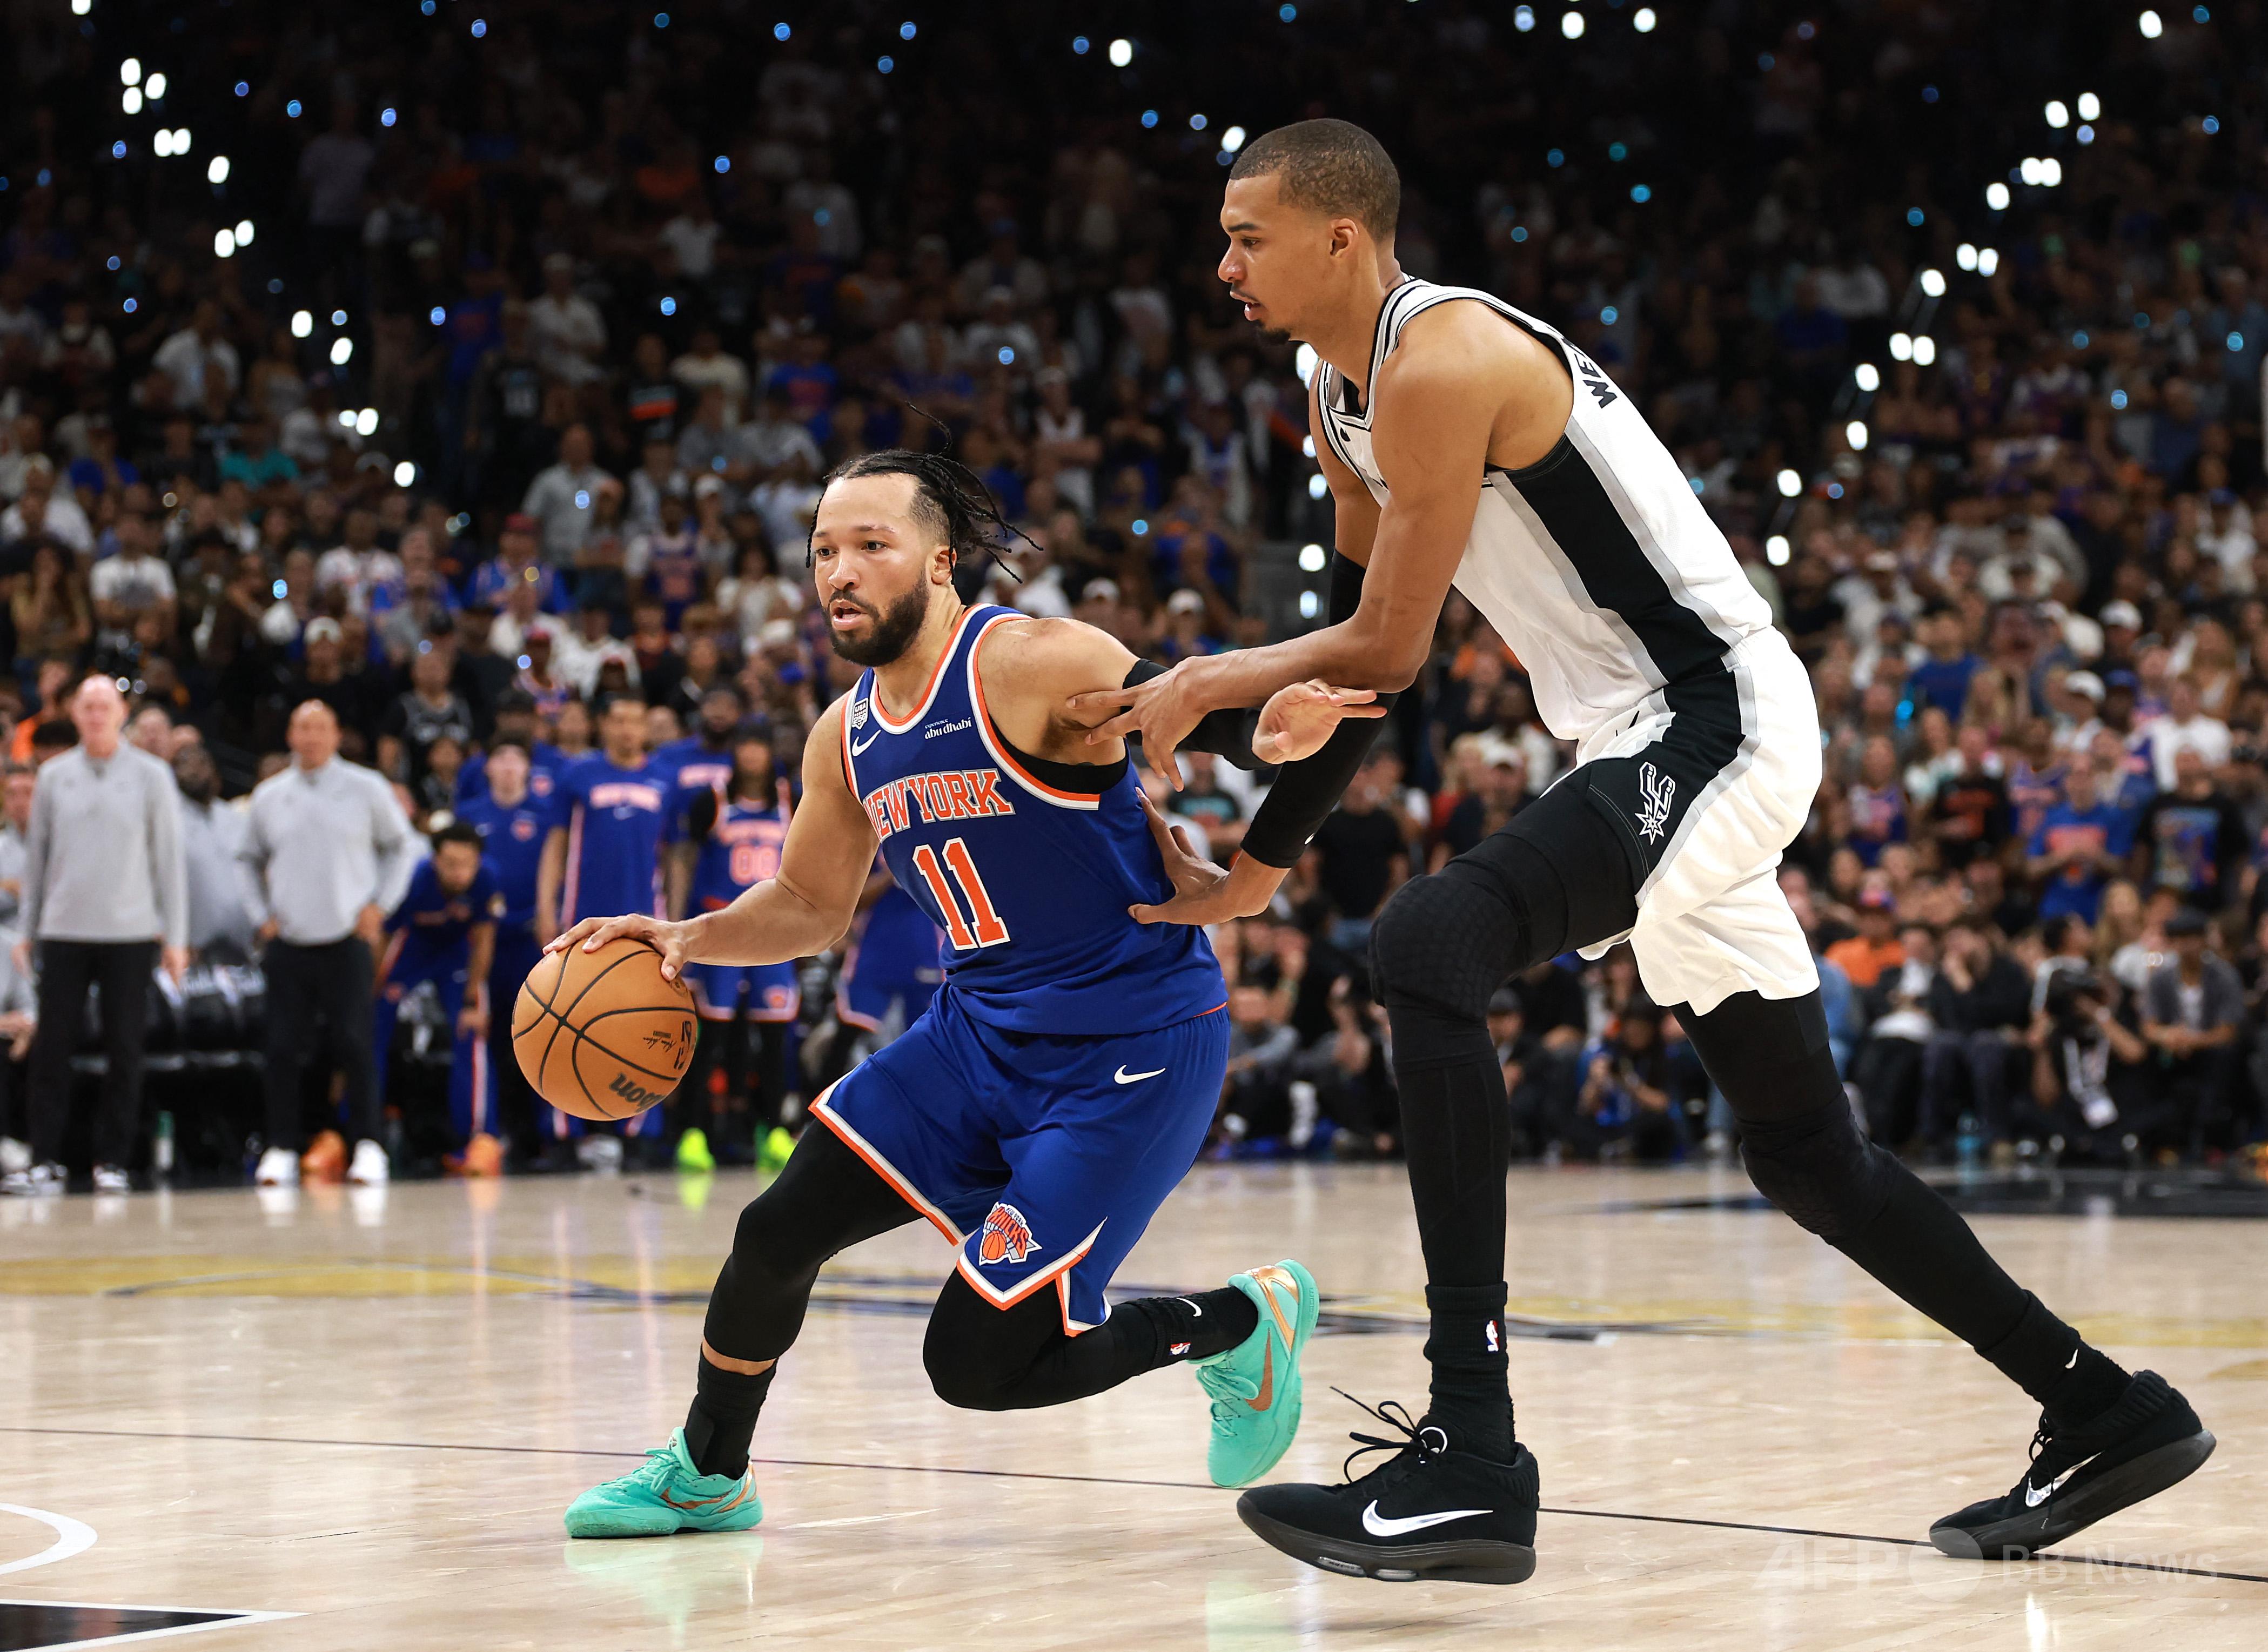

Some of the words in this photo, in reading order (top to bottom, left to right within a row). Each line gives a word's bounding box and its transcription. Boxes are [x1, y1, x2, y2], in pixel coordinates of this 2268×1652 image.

[924, 728, 943, 740] abu
[863, 781, 911, 844] NEW
[904, 768, 1016, 824] YORK
[912, 837, 1011, 951] 11
[987, 1206, 1029, 1259] KNICKS
